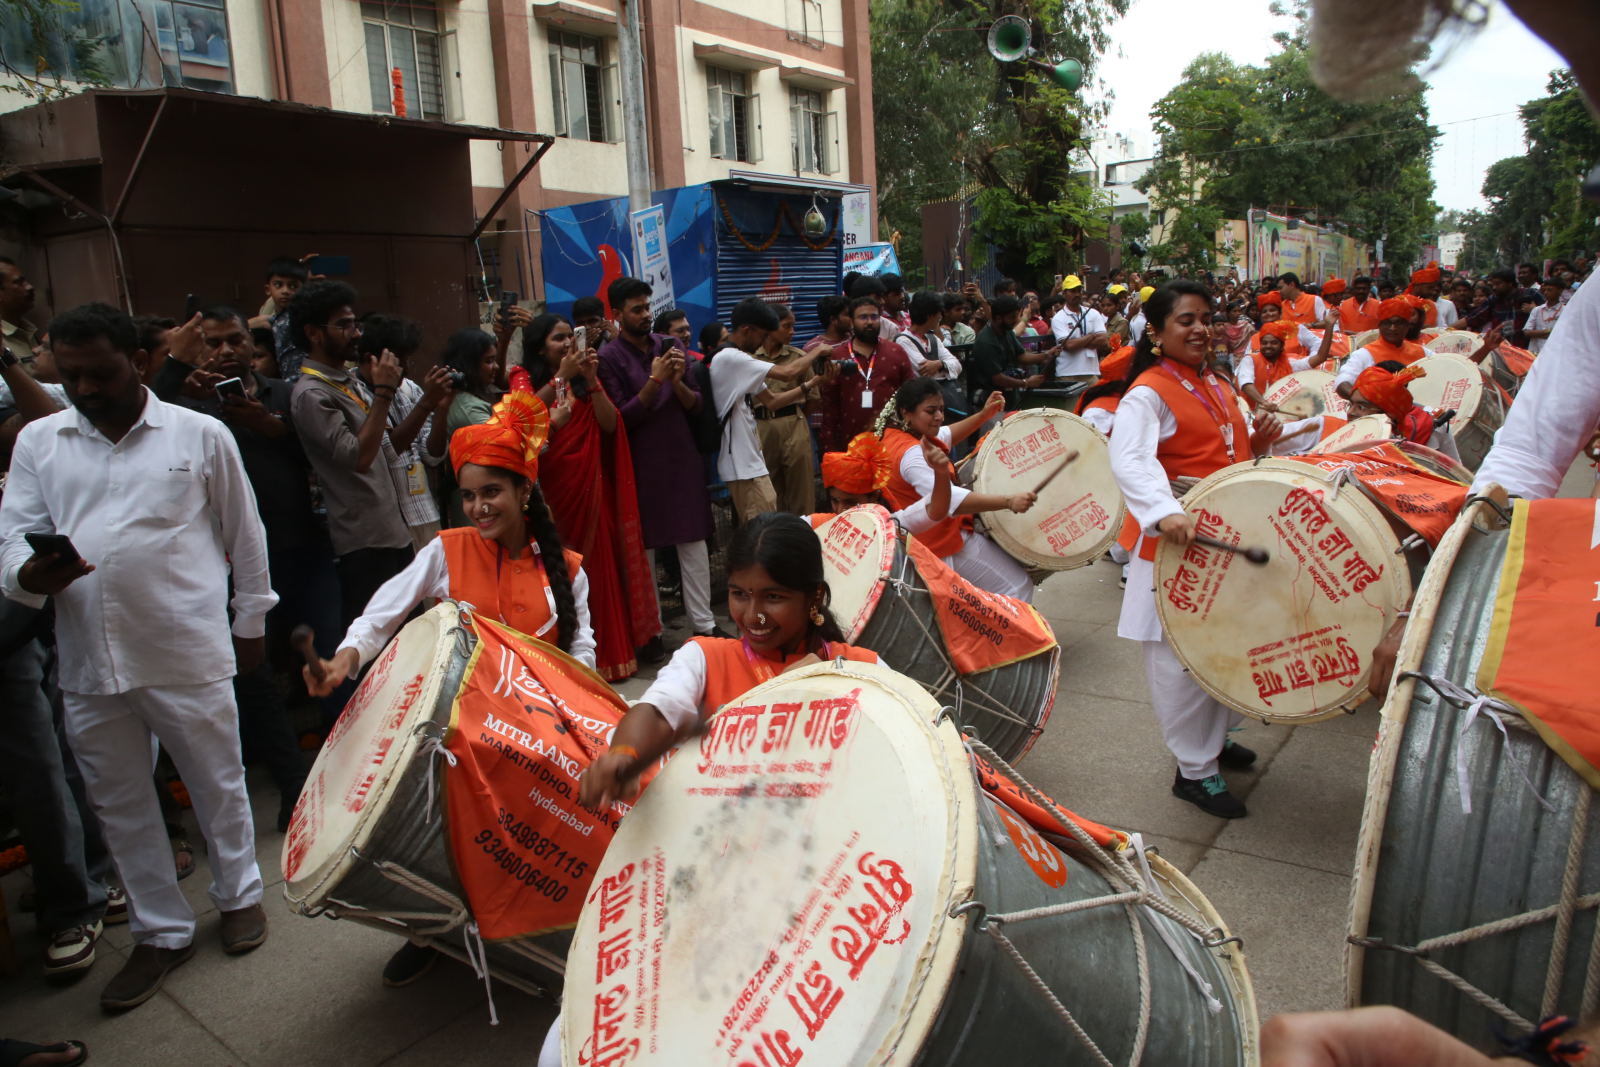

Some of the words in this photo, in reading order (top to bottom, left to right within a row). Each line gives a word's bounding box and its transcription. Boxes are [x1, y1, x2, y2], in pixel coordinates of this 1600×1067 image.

[479, 732, 548, 783] MARATHI
[538, 769, 573, 801] DHOL
[497, 807, 589, 880] 9849887115
[527, 786, 595, 838] Hyderabad
[474, 829, 569, 903] 9346006400
